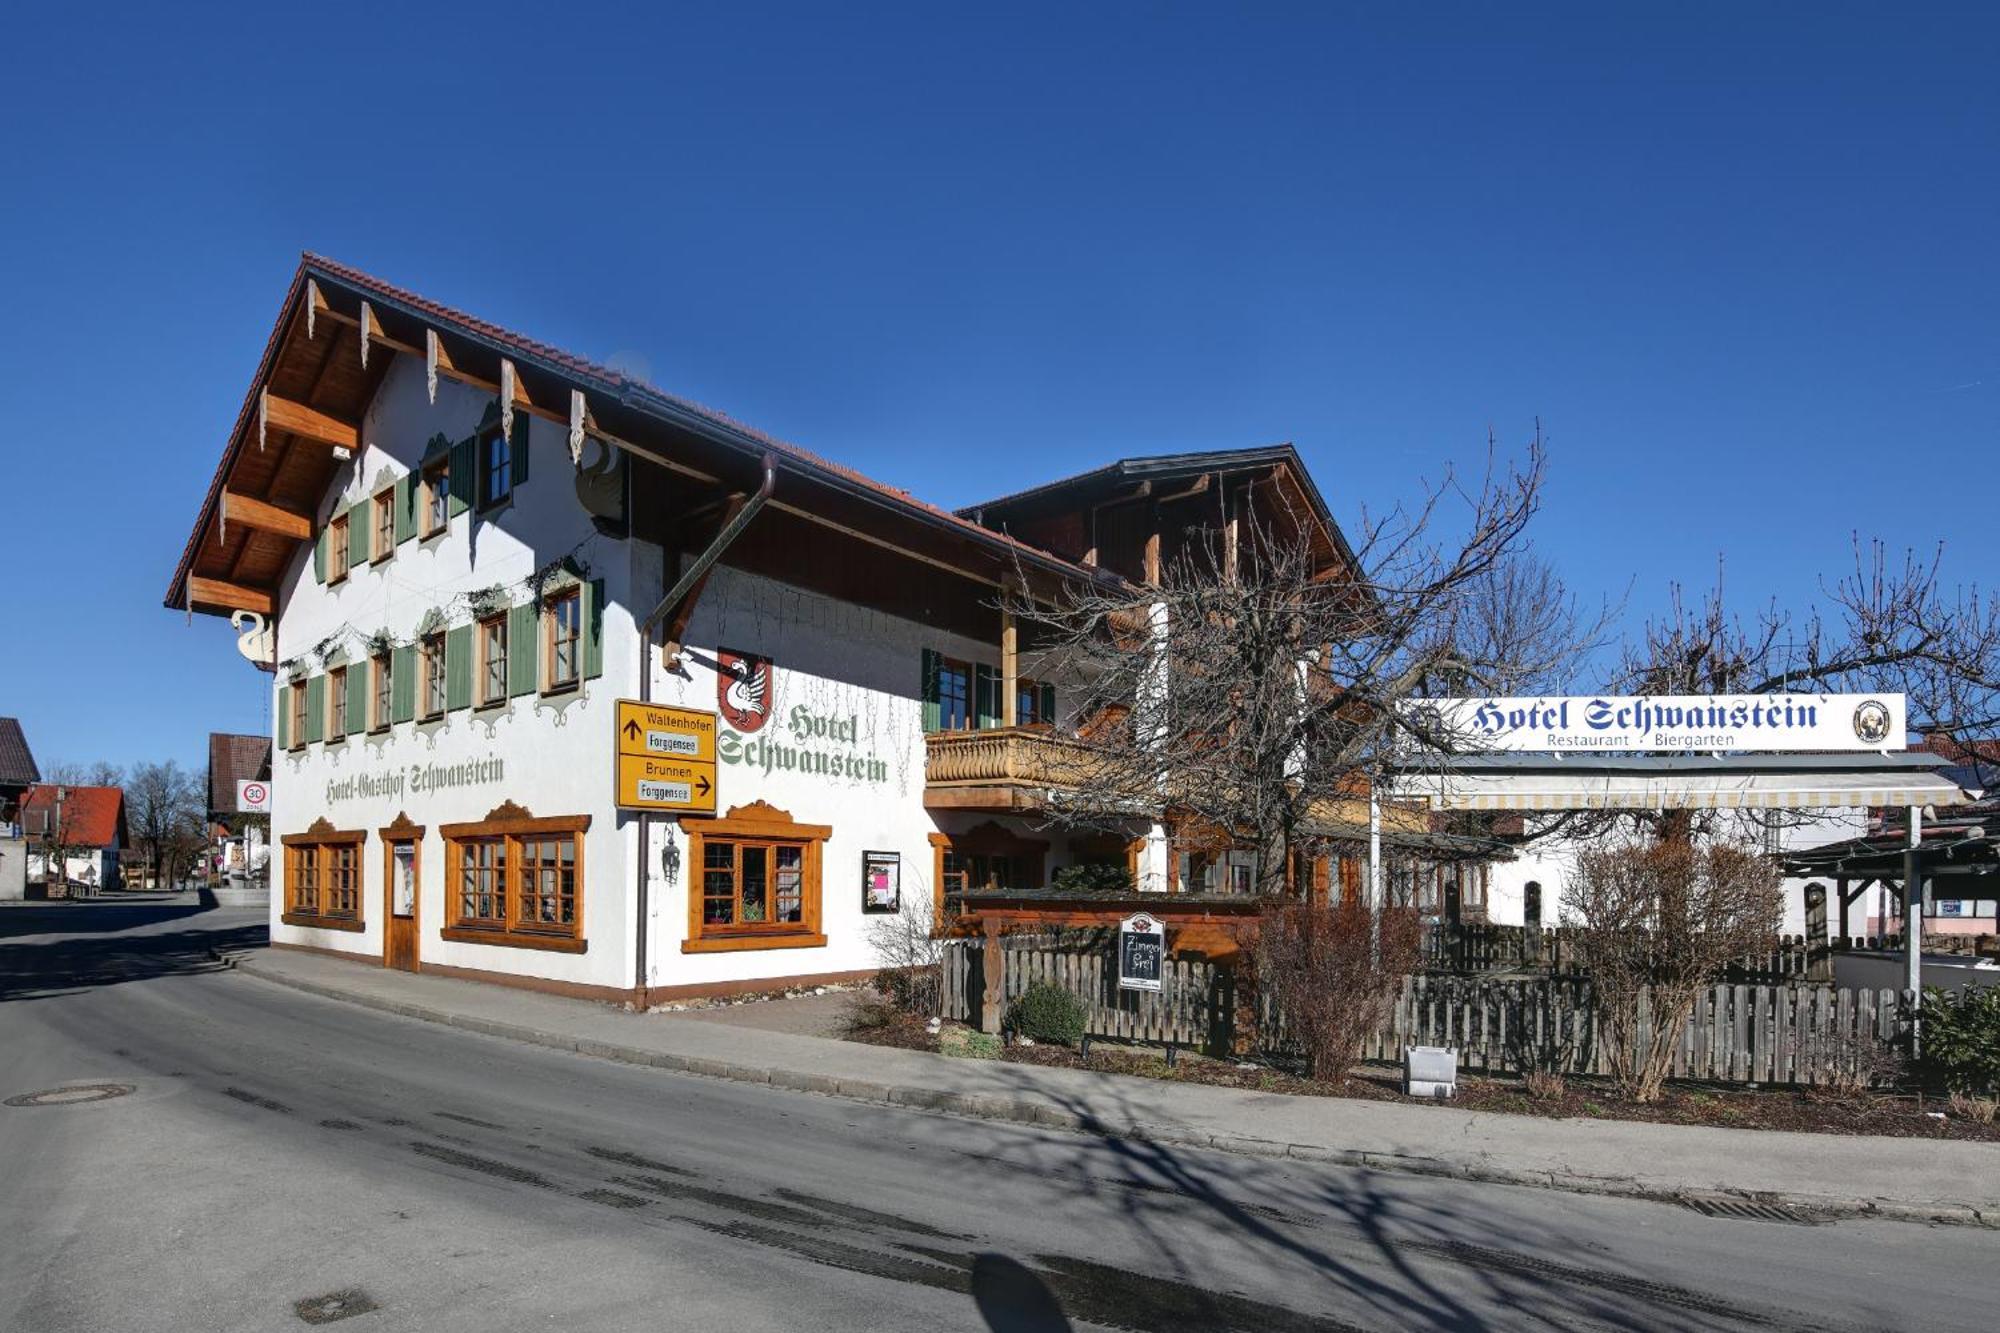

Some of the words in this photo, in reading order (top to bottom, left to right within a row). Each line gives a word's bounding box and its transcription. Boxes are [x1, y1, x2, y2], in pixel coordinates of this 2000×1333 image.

[646, 711, 713, 731] Waltenhofen
[788, 703, 857, 745] Hotel
[1473, 699, 1569, 737] Hotel
[1584, 698, 1817, 737] Schwanstein
[650, 733, 696, 752] Forggensee
[1547, 734, 1629, 746] Restaurant
[1655, 733, 1734, 749] Biergarten
[718, 729, 888, 783] Schwanstein
[646, 761, 692, 778] Brunnen
[326, 767, 405, 808] Hotel-Gasthof
[410, 752, 504, 799] Schwanstein
[248, 788, 261, 799] 30
[641, 784, 688, 800] Forggensee
